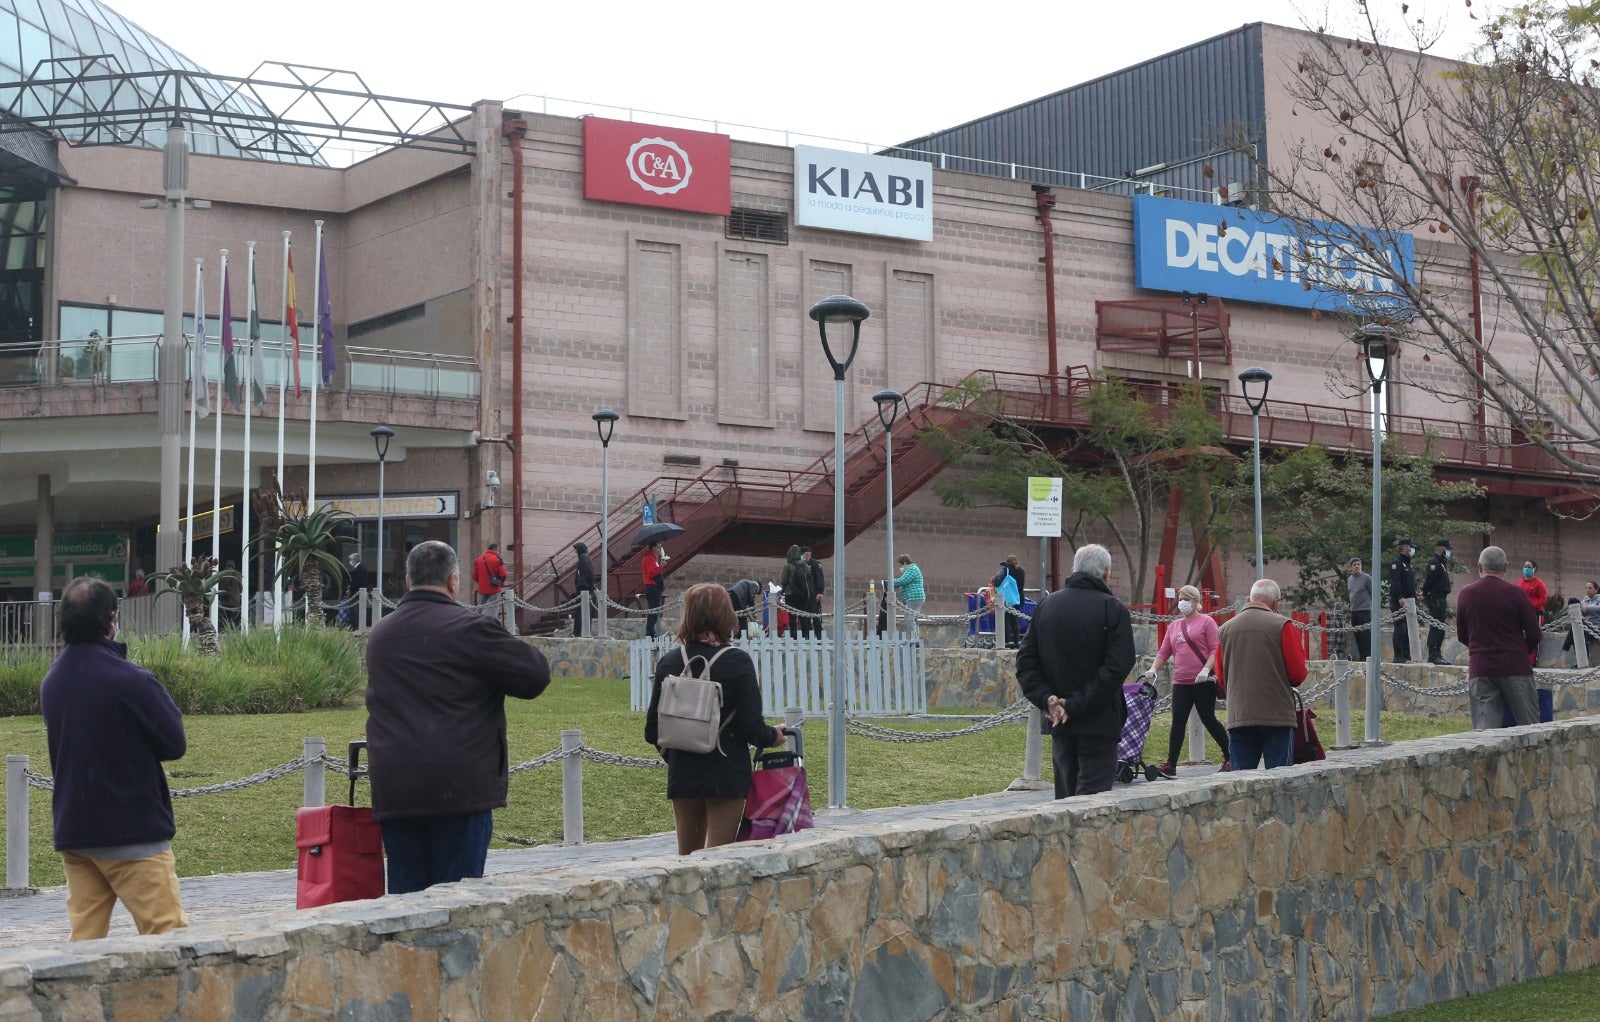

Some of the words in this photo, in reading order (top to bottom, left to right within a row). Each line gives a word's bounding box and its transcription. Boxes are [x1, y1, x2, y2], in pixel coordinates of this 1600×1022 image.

[637, 150, 681, 181] C&A
[808, 163, 924, 209] KIABI
[808, 198, 816, 206] la
[818, 199, 843, 211] moda
[845, 204, 852, 212] a
[854, 205, 893, 218] pequeños
[896, 210, 924, 221] precios
[1165, 218, 1393, 293] DECATHLON
[52, 543, 103, 553] envenidos
